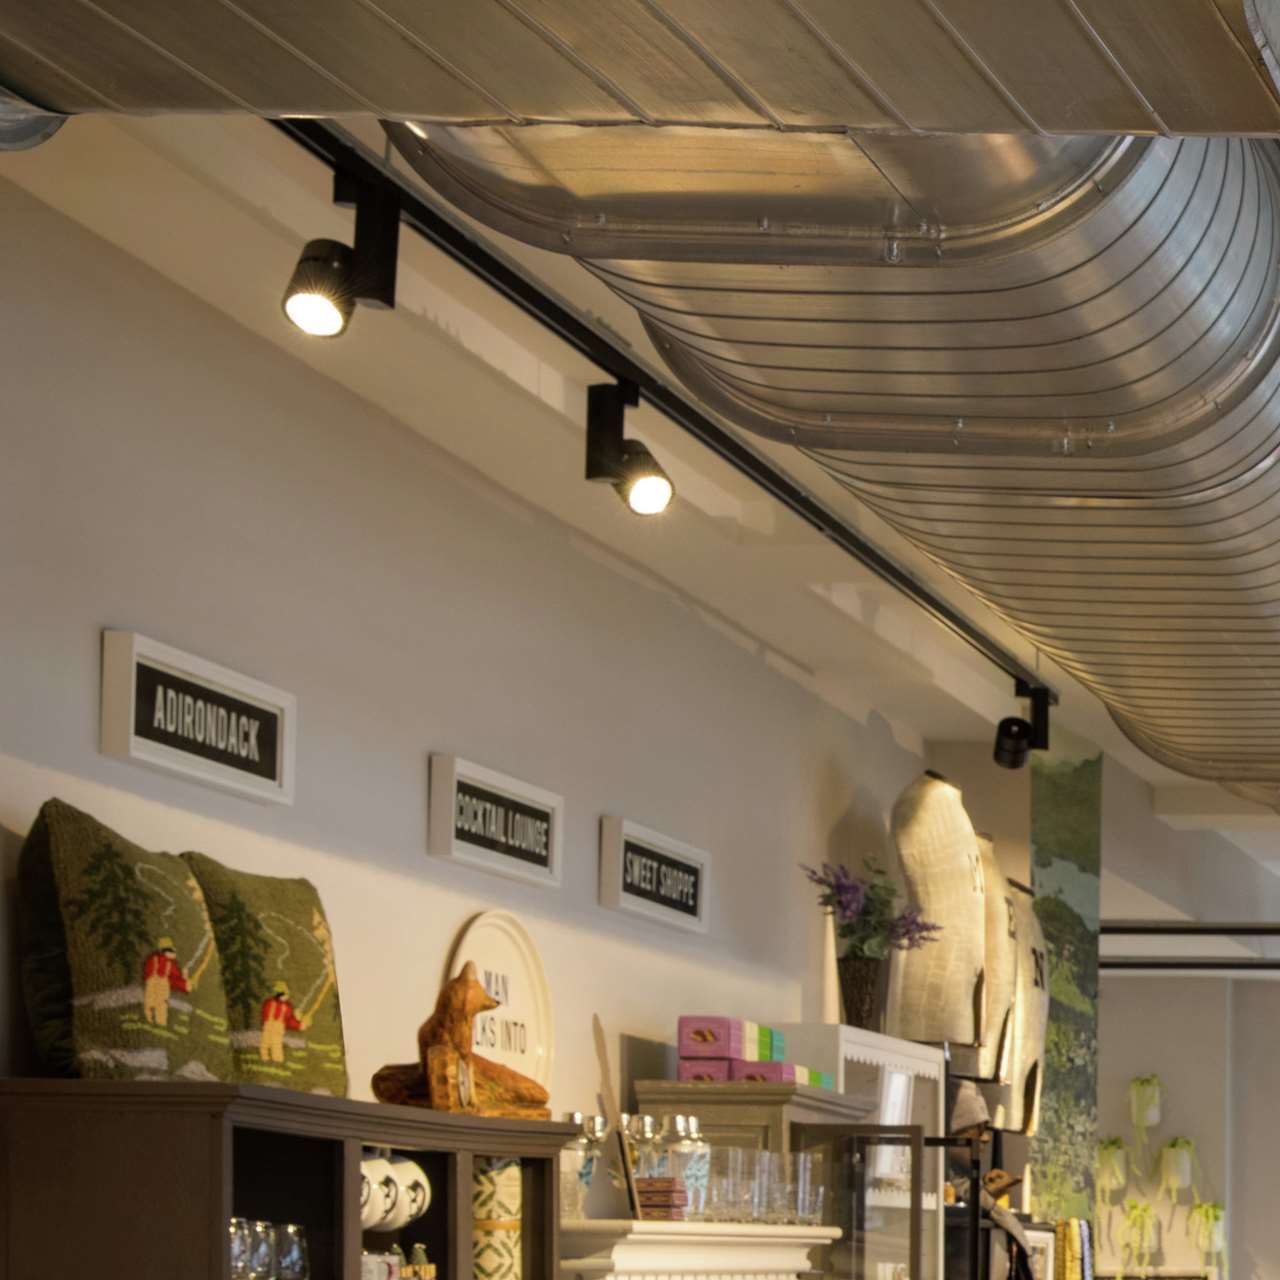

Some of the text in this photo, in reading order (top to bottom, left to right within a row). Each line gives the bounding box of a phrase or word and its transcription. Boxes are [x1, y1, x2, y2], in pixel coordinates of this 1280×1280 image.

[153, 684, 260, 762] ADIRONDACK
[456, 793, 548, 856] COCKTAIL LOUNGE
[625, 852, 695, 906] SWEET SHOPPE
[502, 1019, 526, 1054] INTO
